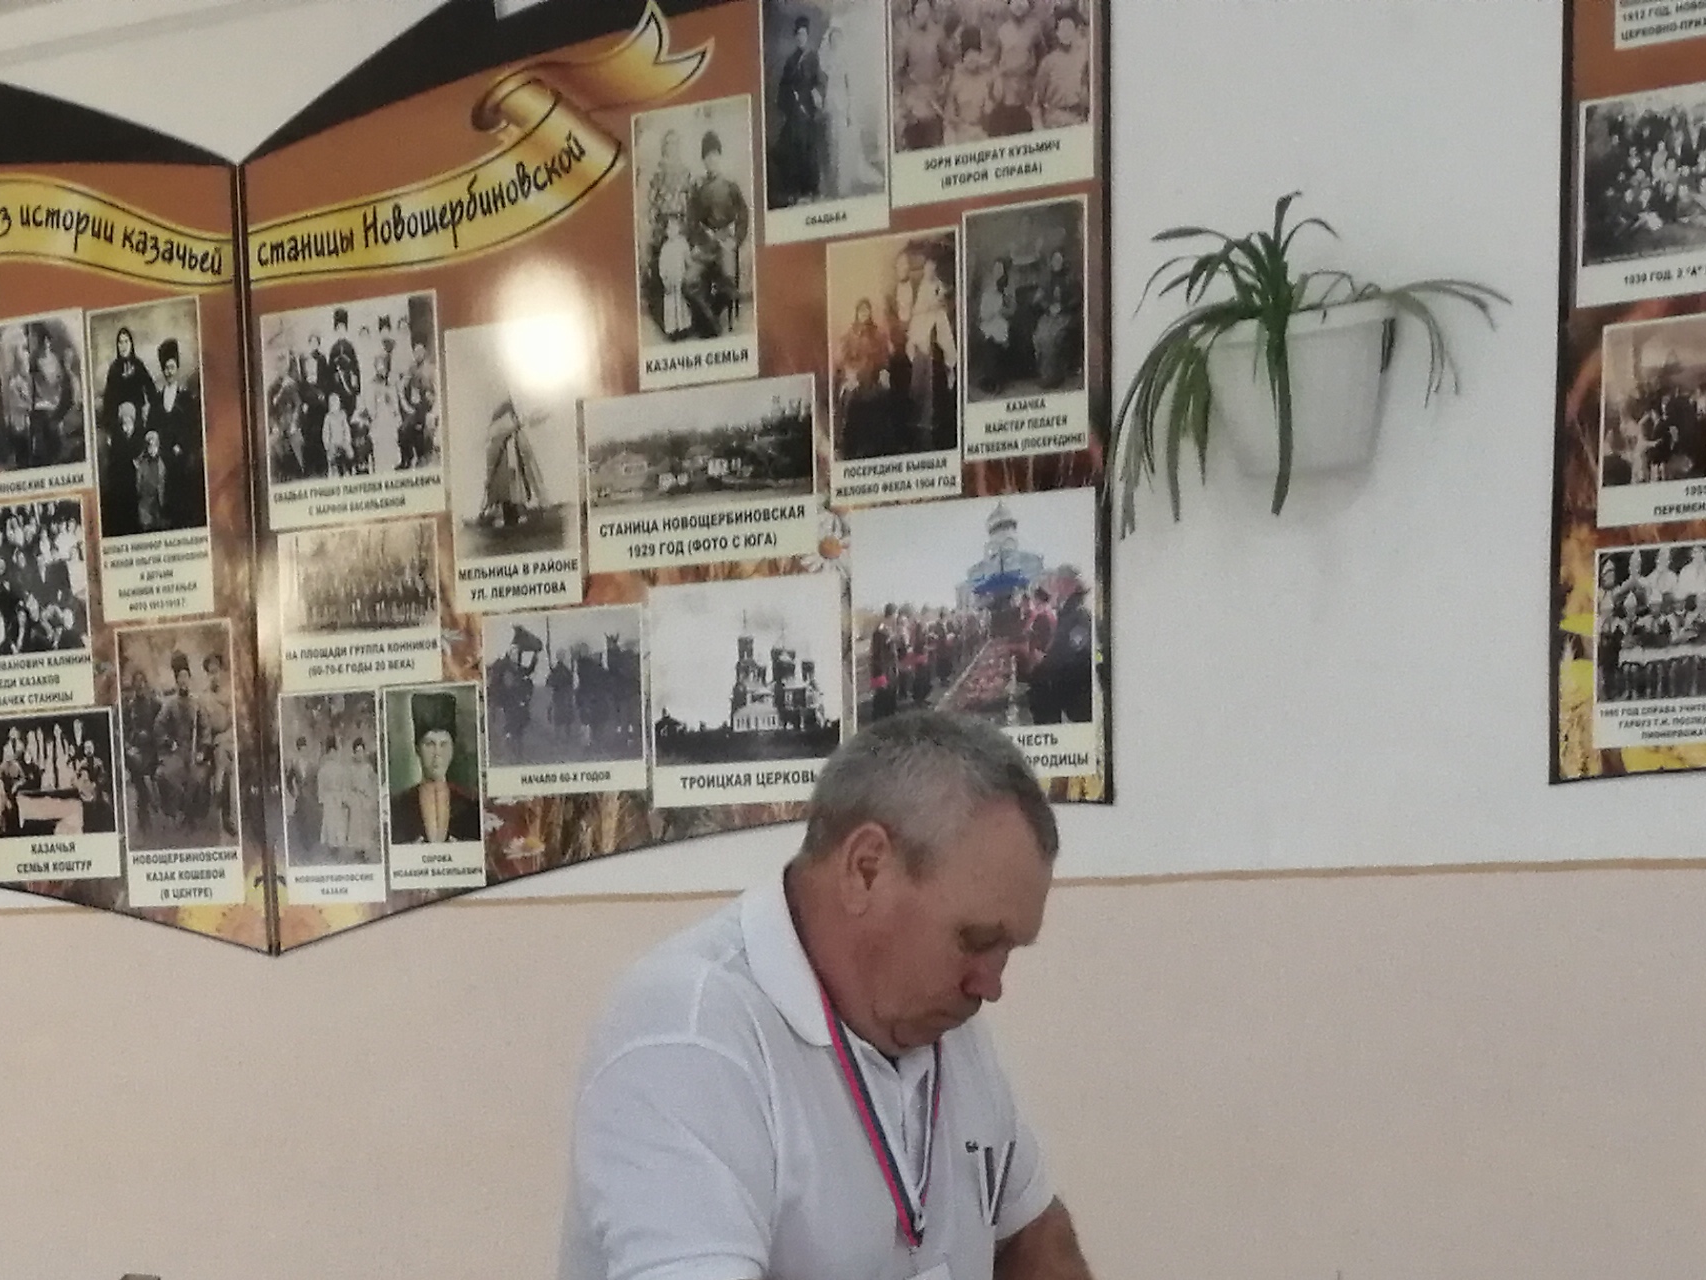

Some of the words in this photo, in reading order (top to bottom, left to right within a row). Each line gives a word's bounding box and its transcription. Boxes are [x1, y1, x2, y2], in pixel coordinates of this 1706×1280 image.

[954, 148, 1005, 166] КОНДРАТ
[1008, 140, 1061, 157] КУЗЬМИЧ
[941, 169, 988, 189] (ВТОРОЙ
[995, 162, 1042, 179] СПРАВА)
[20, 203, 114, 252] истории
[122, 224, 222, 276] казачьей
[257, 226, 354, 267] станицы
[645, 355, 702, 374] КАЗАЧЬЯ
[703, 349, 749, 367] СЕМЬЯ
[843, 462, 902, 479] ПОСЕРЕДИНЕ
[48, 474, 84, 486] КАЗАКИ
[835, 483, 879, 497] ЖЕЛОБКО
[881, 479, 912, 494] ФЕКЛА
[938, 475, 956, 488] ГОД
[599, 521, 659, 538] СТАНИЦА
[663, 504, 805, 531] НОВОЩЕРБИНОВСКАЯ
[659, 540, 684, 556] ГОД
[688, 536, 727, 555] (ФОТО
[733, 535, 740, 548] С
[744, 532, 777, 548] ЮГА)
[459, 563, 521, 581] МЕЛЬНИЦА
[522, 563, 530, 575] В
[533, 558, 578, 574] РАЙОНЕ
[470, 586, 487, 600] УЛ.
[491, 582, 566, 598] ЛЕРМОНТОВА
[300, 646, 347, 661] ПЛОЩАДИ
[349, 642, 385, 656] ГРУППА
[387, 639, 437, 654] КОННИКОВ
[346, 661, 372, 674] ГОДЫ
[387, 658, 415, 672] ВЕКА)
[27, 691, 73, 705] СТАНИЦЫ
[1016, 733, 1058, 747] ЧЕСТЬ
[1025, 753, 1088, 767] ОРОДИЦЫ
[581, 770, 611, 782] ГОДОВ
[681, 774, 752, 790] ТРОИЦКАЯ
[31, 842, 76, 856] КАЗАЧЬЯ
[132, 850, 238, 866] НОВОЩЕРБИНОВСКИЙ
[16, 860, 50, 874] СЕМЬЯ
[145, 870, 176, 882] КАЗАК
[178, 867, 225, 881] КОШЕВОЙ
[431, 867, 483, 876] ВАСИЛЬЕВИЧ
[160, 889, 171, 900] (В
[173, 885, 213, 900] ЦЕНТРЕ)
